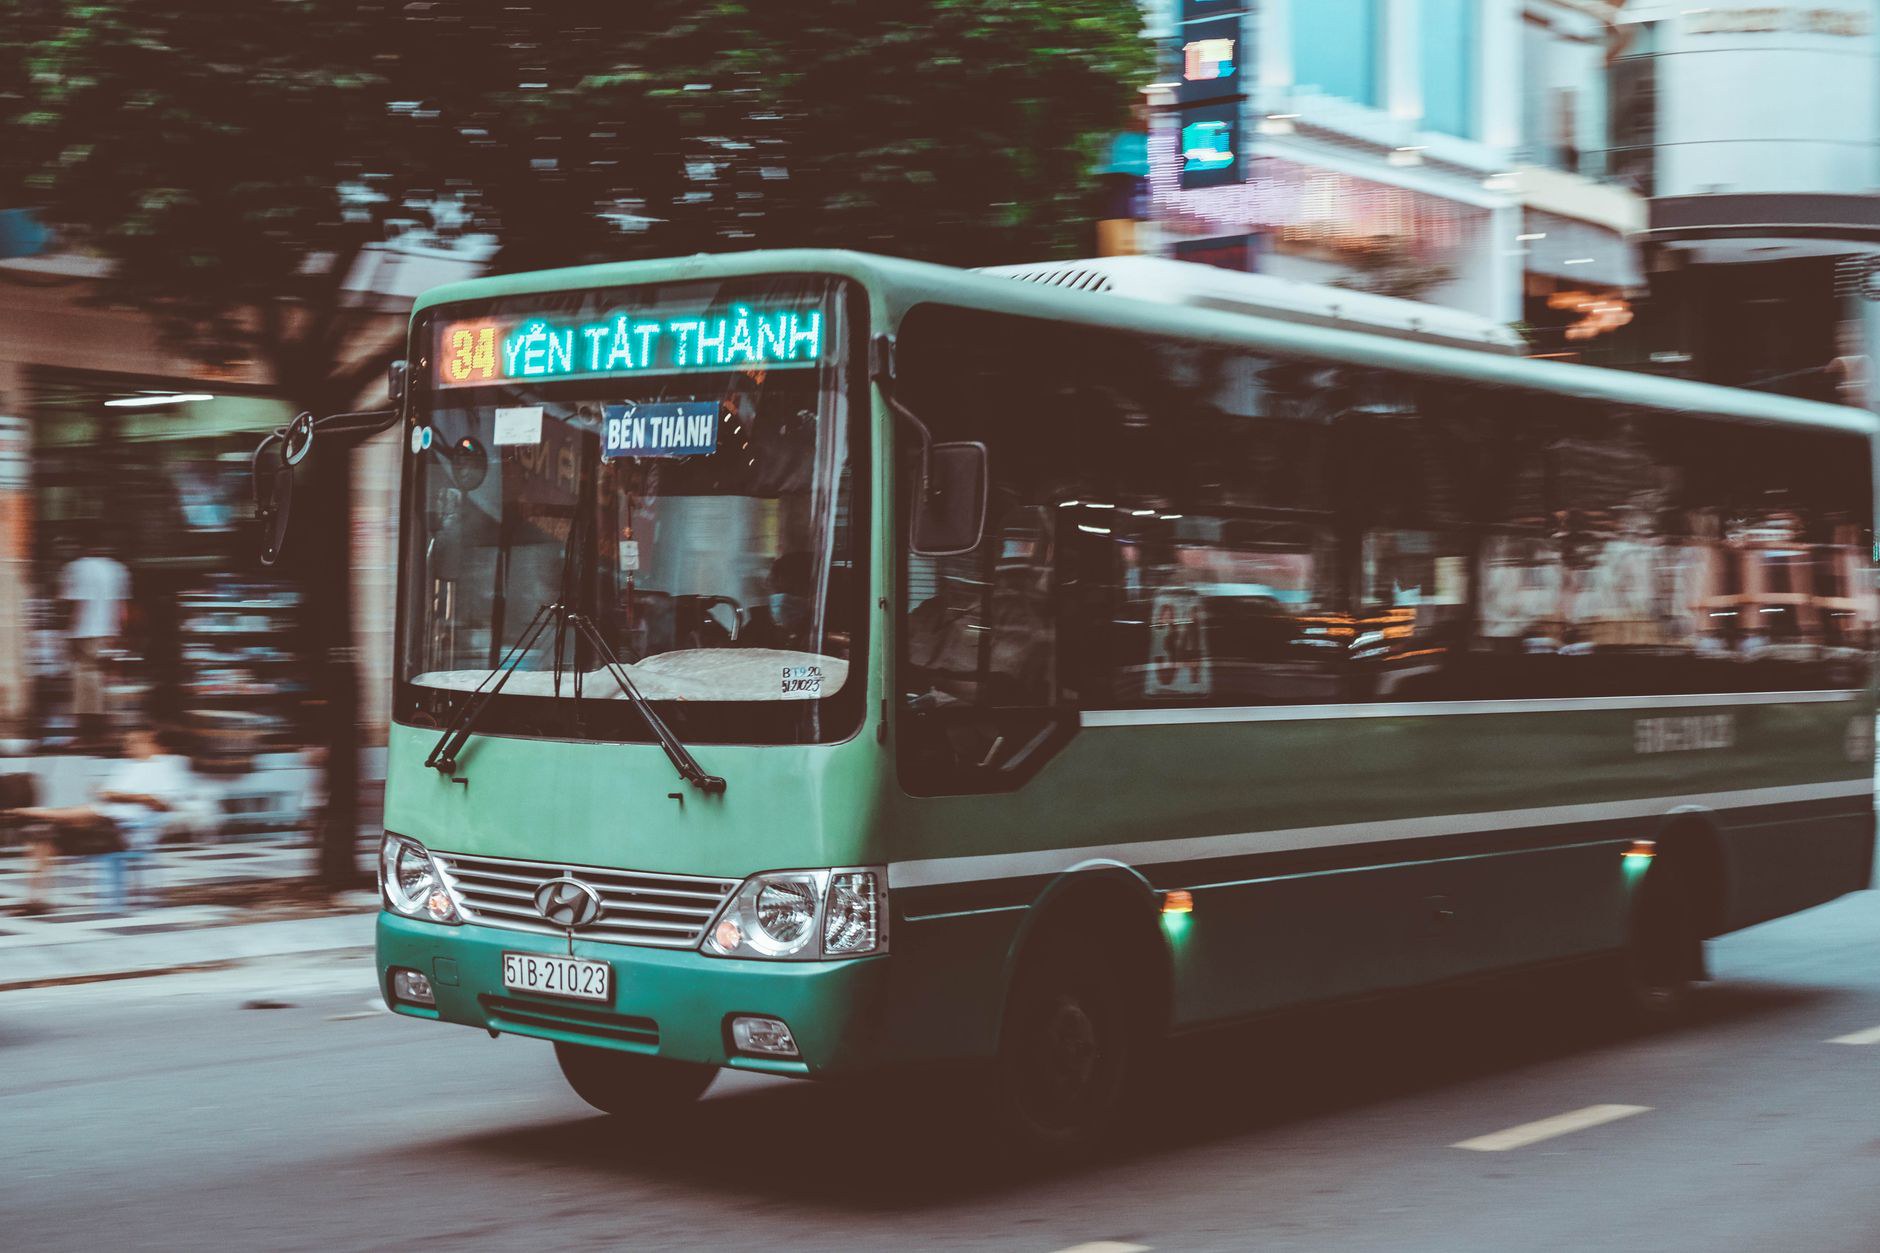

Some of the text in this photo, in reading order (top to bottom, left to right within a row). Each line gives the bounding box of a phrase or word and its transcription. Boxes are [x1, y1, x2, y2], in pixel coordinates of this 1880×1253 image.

[451, 328, 495, 379] 34
[670, 307, 820, 365] THÀNH
[607, 406, 713, 449] BẾN THÀNH
[506, 956, 605, 994] 51B-210.23
